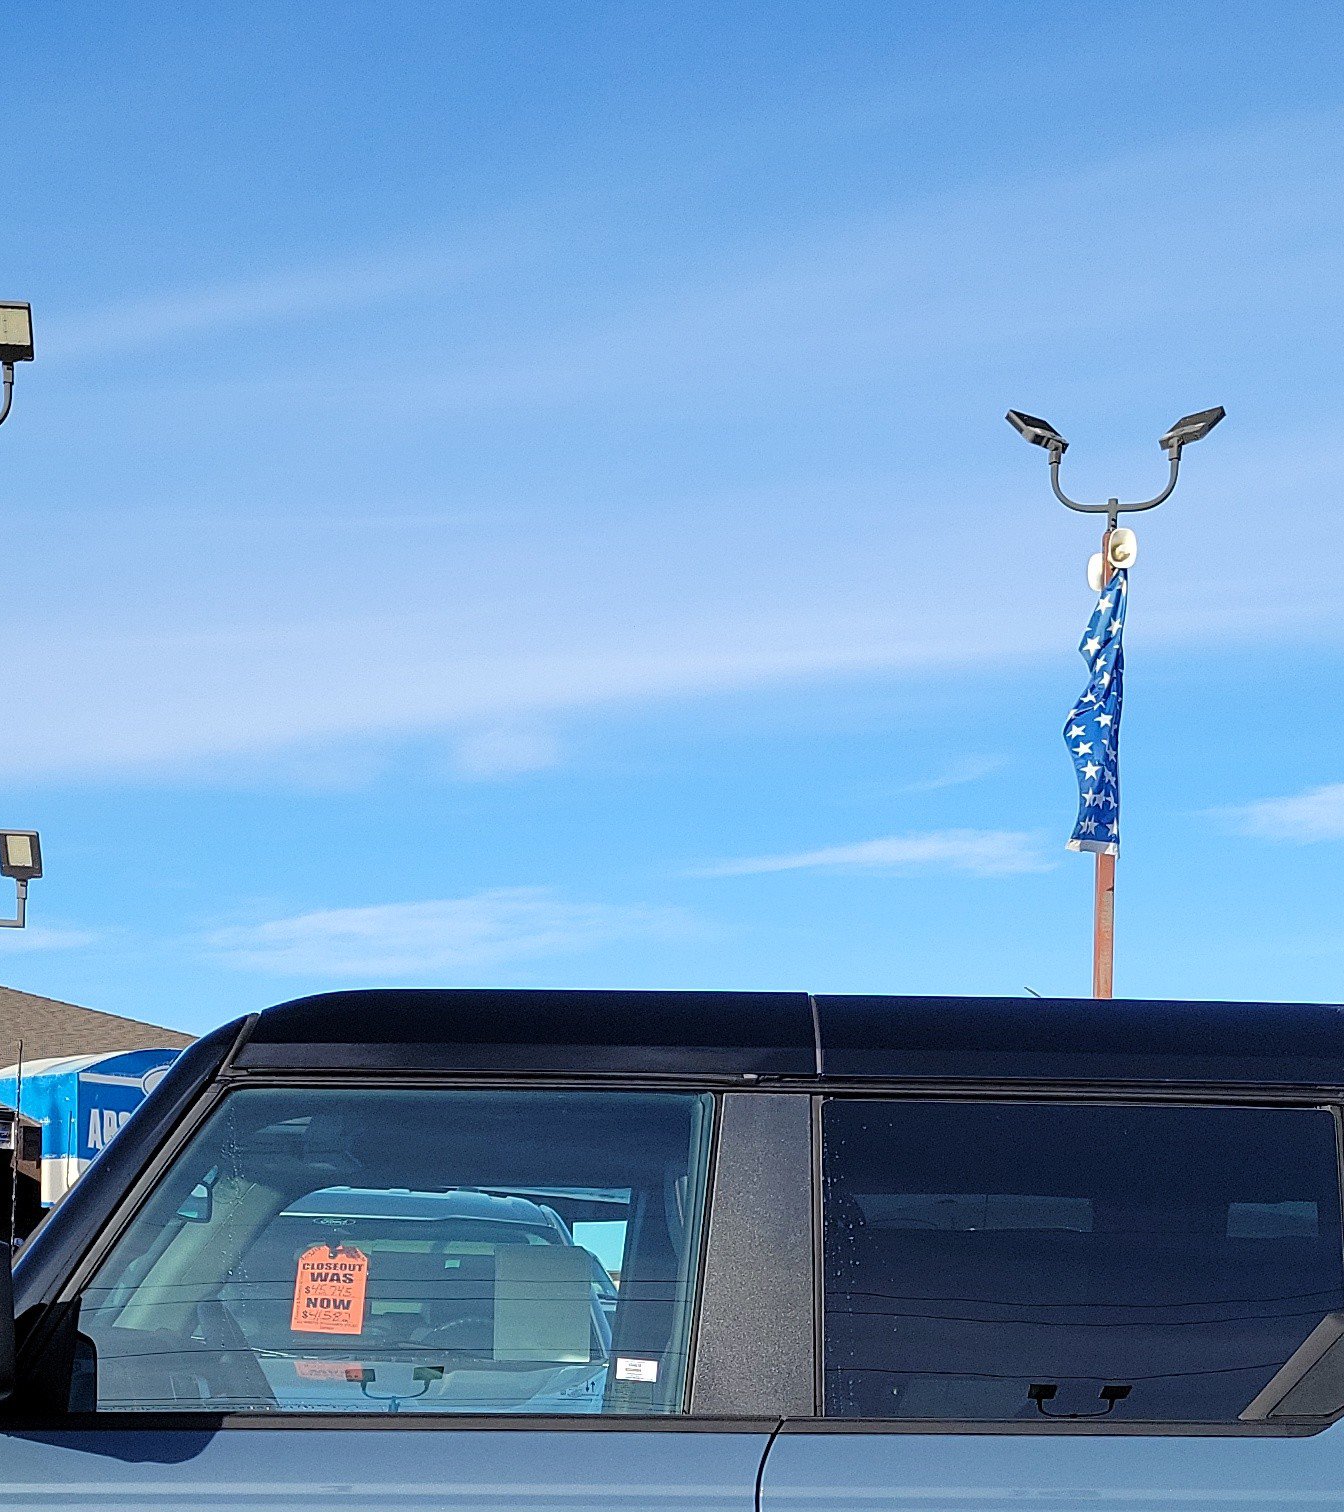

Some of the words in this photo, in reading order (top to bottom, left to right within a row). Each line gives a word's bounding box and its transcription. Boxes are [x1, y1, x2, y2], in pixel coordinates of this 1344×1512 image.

[302, 1262, 364, 1272] CLOSEOUT
[310, 1272, 354, 1284] WAS
[306, 1297, 353, 1310] NOW
